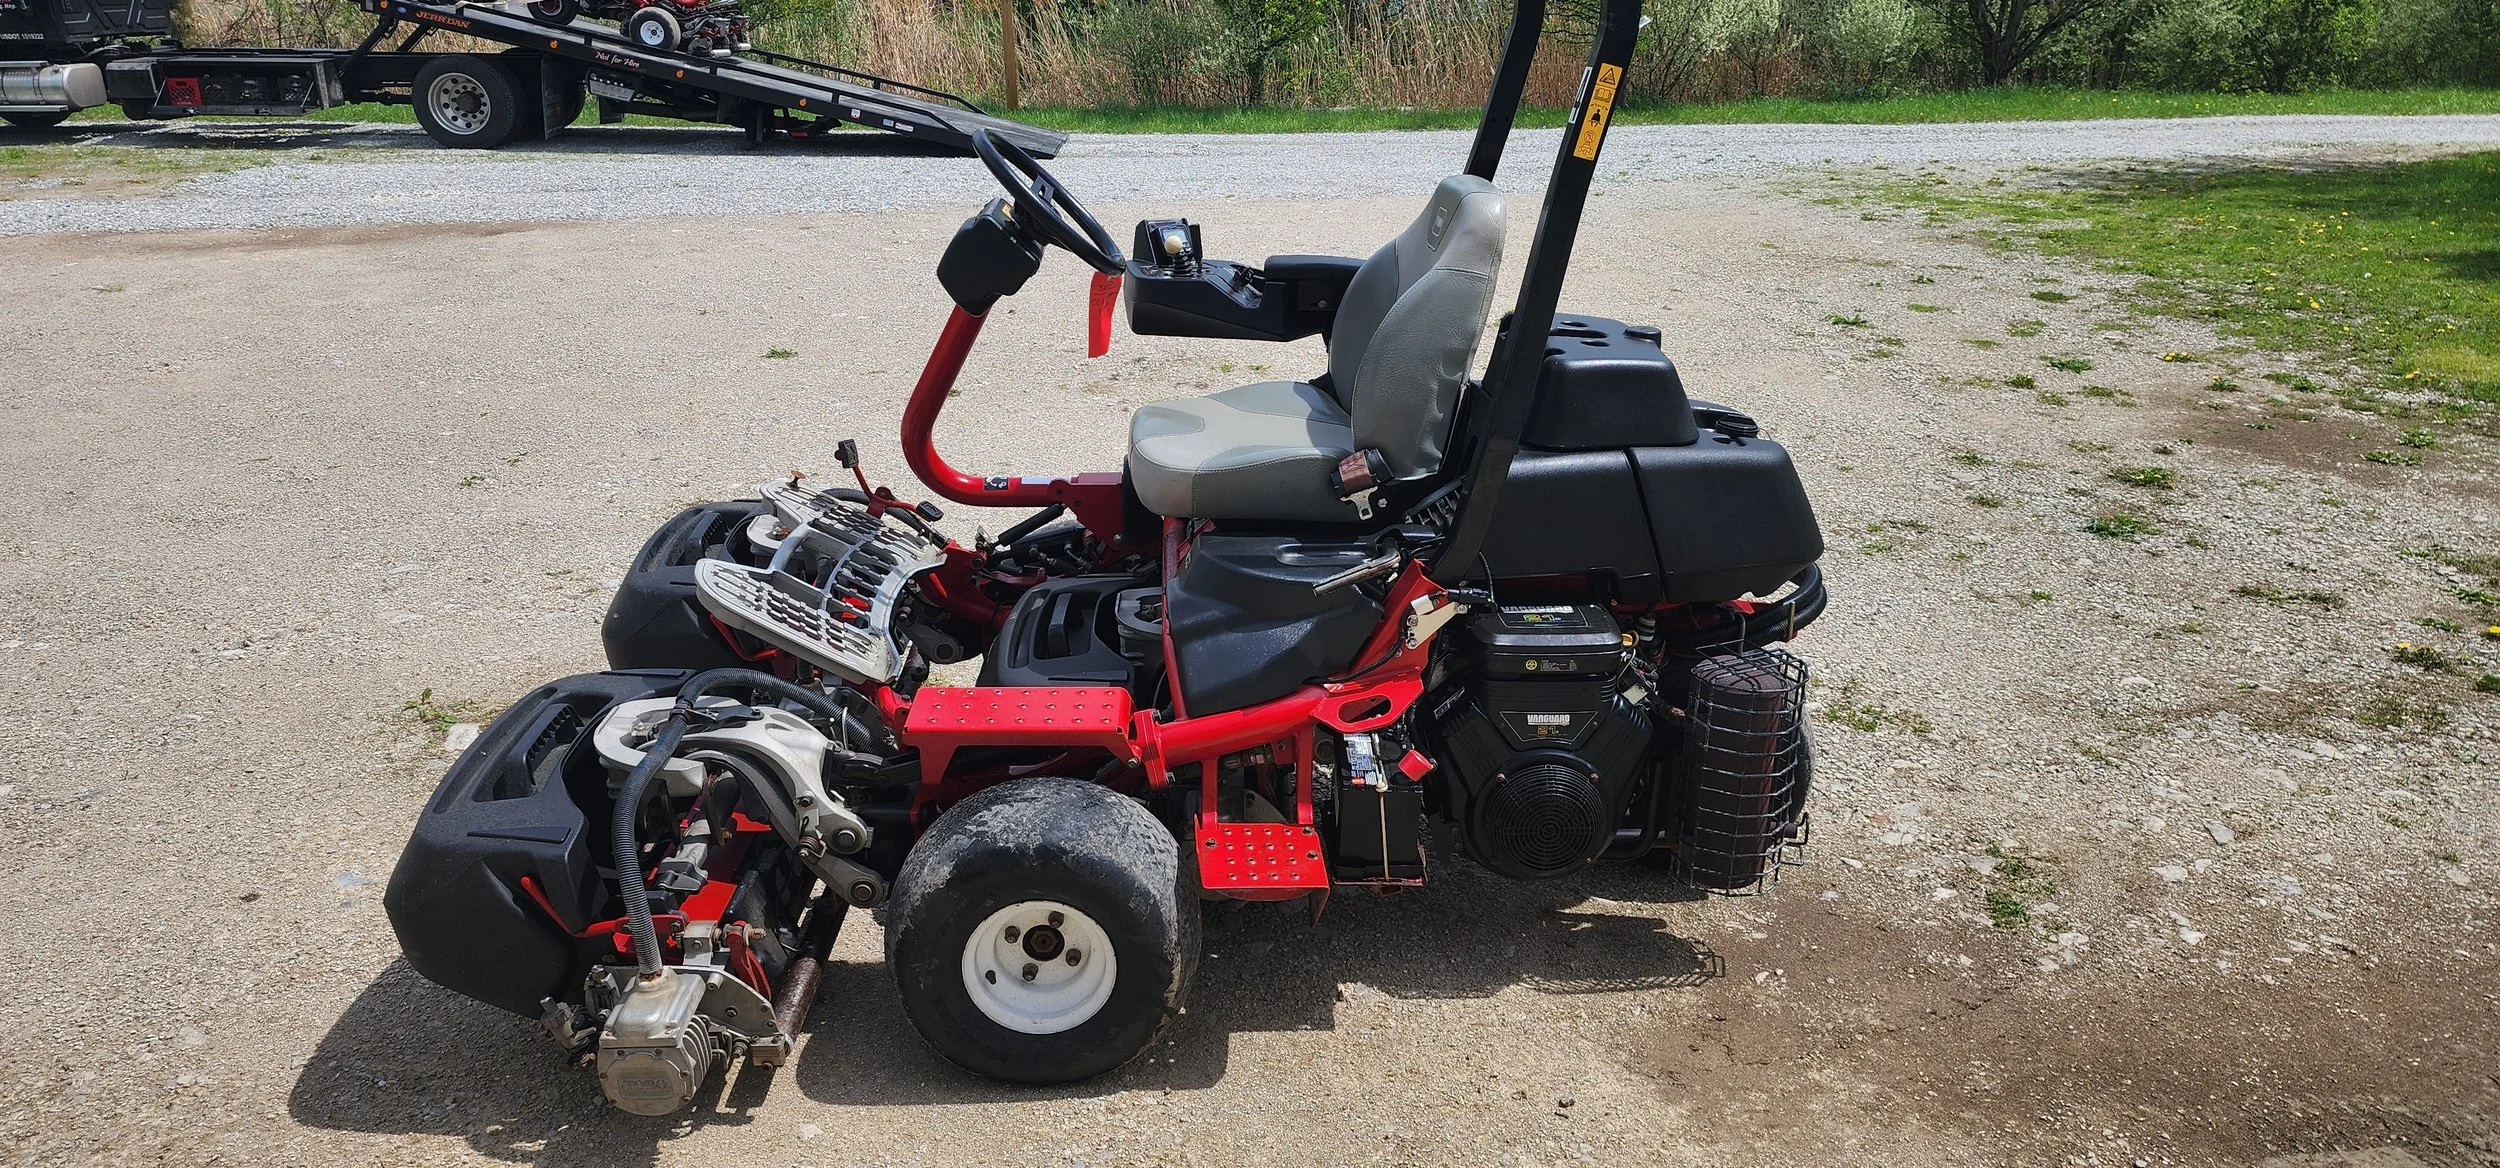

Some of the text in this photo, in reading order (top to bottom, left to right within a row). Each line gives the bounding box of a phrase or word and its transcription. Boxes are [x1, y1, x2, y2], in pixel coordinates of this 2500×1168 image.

[595, 51, 640, 68] Not for Hire
[1527, 714, 1570, 723] VANGUARD
